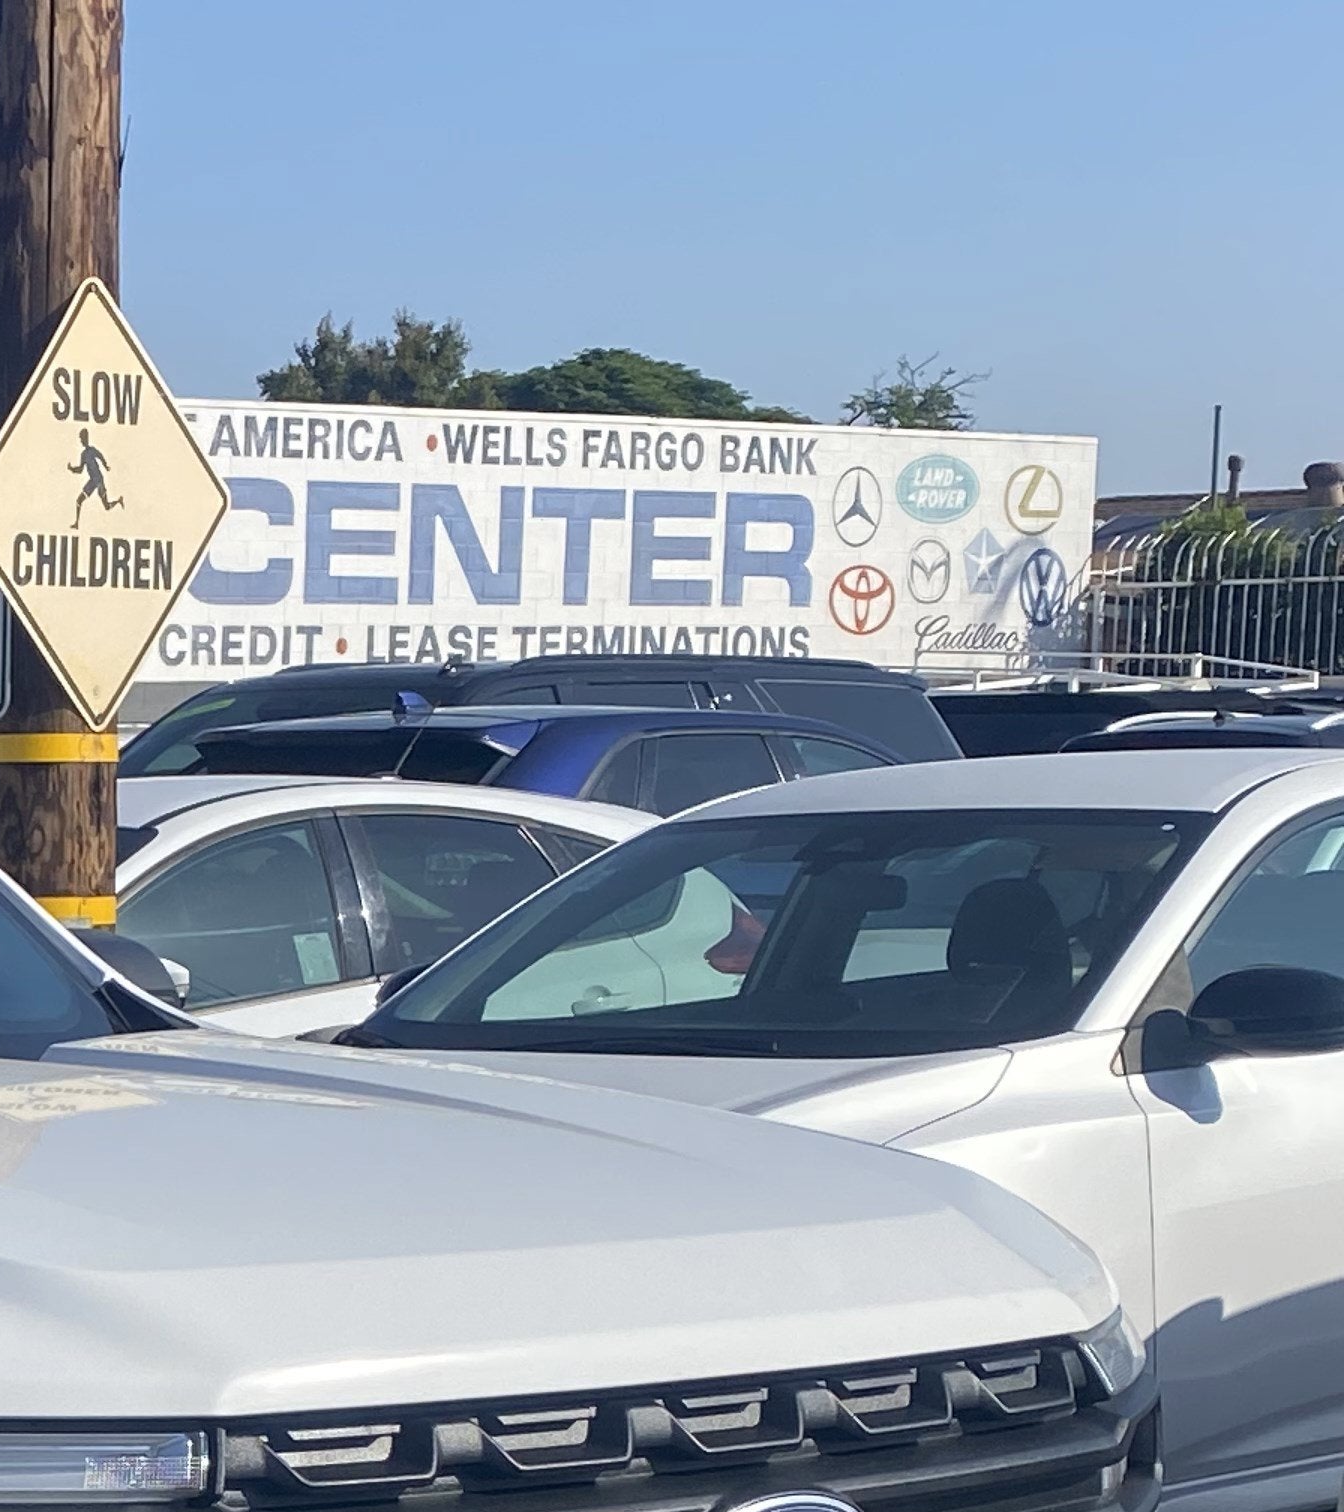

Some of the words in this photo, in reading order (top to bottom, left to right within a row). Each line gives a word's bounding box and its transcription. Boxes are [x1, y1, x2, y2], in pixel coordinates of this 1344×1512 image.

[52, 366, 142, 426] SLOW
[208, 414, 404, 463] AMERICA
[442, 423, 567, 469] WELLS
[581, 429, 705, 472] FARGO
[719, 435, 818, 476] BANK
[916, 488, 967, 509] ROVER
[12, 532, 174, 591] CHILDREN
[186, 476, 816, 608] CENTER
[159, 623, 323, 667] CREDIT
[367, 624, 498, 663] LEASE
[512, 626, 811, 659] TERMINATIONS
[915, 614, 1019, 651] Cadillac
